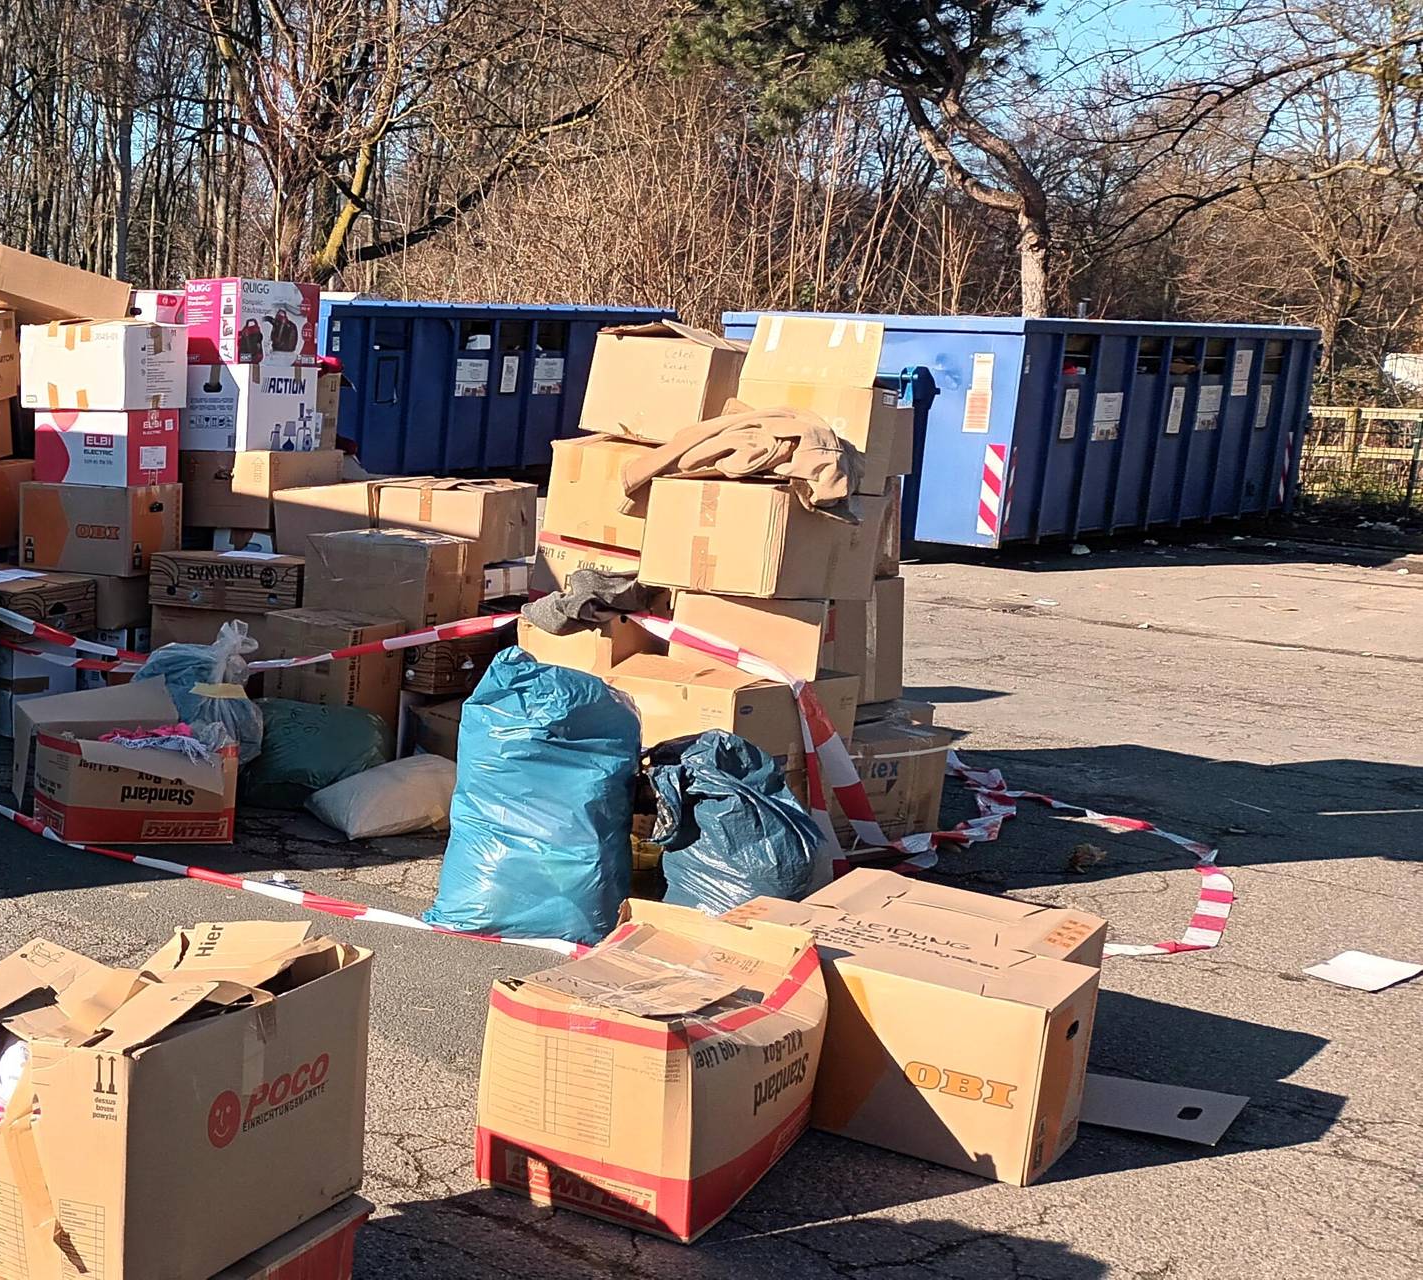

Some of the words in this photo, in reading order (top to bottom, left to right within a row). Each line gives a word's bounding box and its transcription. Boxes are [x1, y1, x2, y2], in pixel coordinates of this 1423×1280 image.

[187, 283, 211, 293] QUIGG
[242, 281, 270, 295] QUIGG
[268, 377, 306, 395] ACTION
[85, 435, 112, 446] ELBI
[75, 524, 120, 540] OBI
[187, 562, 254, 581] BANANAS
[78, 758, 103, 772] Liter
[120, 785, 195, 805] Standard
[143, 822, 227, 838] HELLWEG
[194, 921, 224, 958] Hier
[838, 915, 971, 951] KLEIDUNG
[694, 1041, 720, 1071] Liter
[721, 1040, 742, 1062] 109
[762, 1029, 804, 1064] XXL-Box
[244, 1051, 330, 1121] POCO
[752, 1052, 810, 1116] Standard
[904, 1060, 1018, 1110] OBI
[241, 1081, 329, 1133] EINRICHTUNGSMÄRKTE
